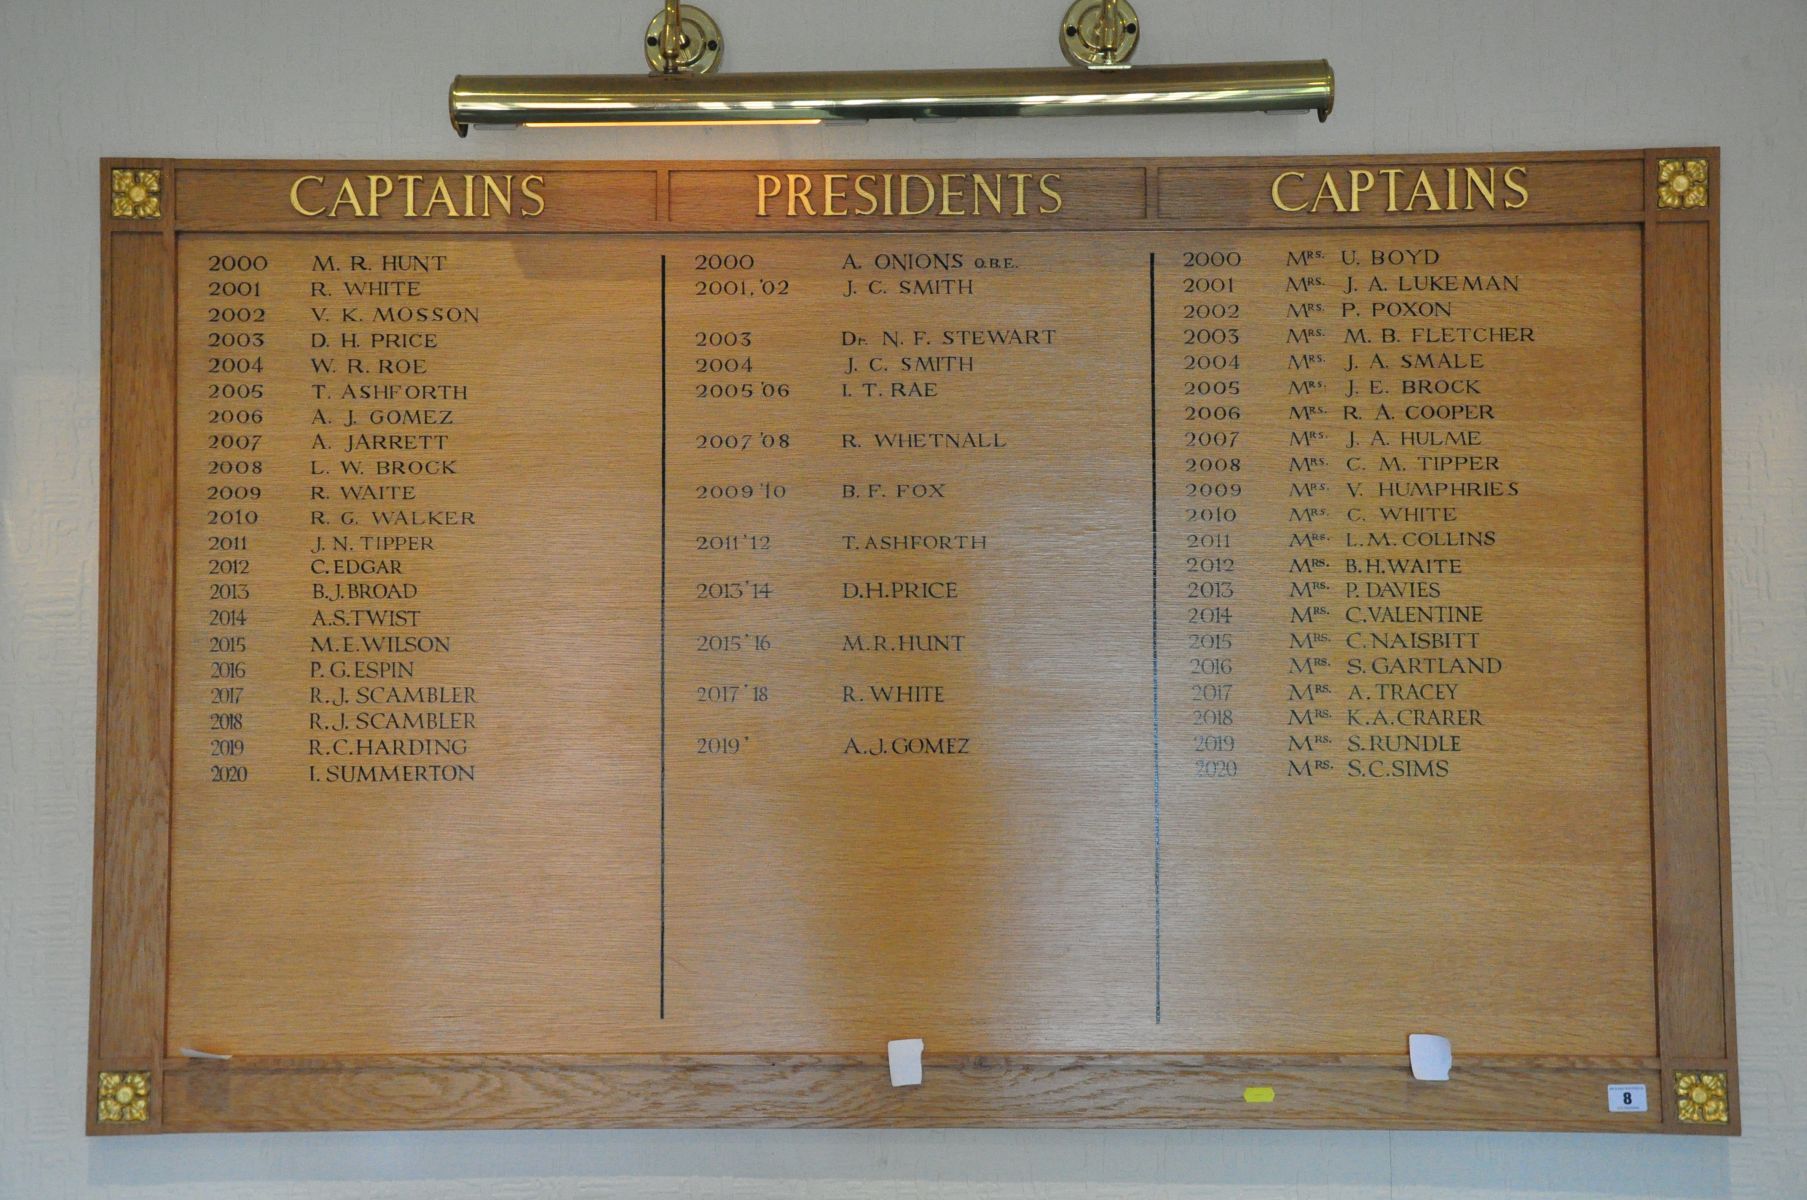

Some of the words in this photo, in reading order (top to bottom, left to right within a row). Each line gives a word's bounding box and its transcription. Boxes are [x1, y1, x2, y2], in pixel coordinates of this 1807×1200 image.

[290, 175, 544, 216] CAPTAINS
[757, 174, 1061, 215] PRESIDENTS
[1272, 167, 1528, 211] CAPTAINS
[209, 256, 268, 271] 2000
[312, 256, 340, 271] M.
[350, 256, 371, 271] R.
[383, 255, 447, 272] HUNT
[695, 255, 754, 270] 2000
[842, 254, 862, 269] A.
[875, 253, 963, 271] ONIONS
[1183, 252, 1241, 267] 2000
[1342, 250, 1360, 265] U.
[1372, 249, 1439, 265] BOYD
[209, 282, 260, 297] 2001
[311, 282, 331, 297] R.
[344, 281, 421, 296] WHITE
[843, 280, 856, 297] J.
[869, 280, 886, 294] C.
[900, 279, 973, 295] SMITH
[1183, 277, 1233, 292] 2001
[1344, 276, 1357, 294] J.
[1368, 276, 1387, 291] A.
[1399, 276, 1518, 291] LUKEMAN
[208, 308, 265, 322] 2002
[311, 308, 329, 322] V.
[343, 308, 363, 323] K.
[373, 307, 479, 323] MOSSON
[1184, 304, 1239, 318] 2002
[1342, 302, 1360, 317] P.
[1372, 302, 1451, 317] POXON
[208, 333, 264, 347] 2003
[312, 333, 329, 348] D.
[342, 333, 360, 348] H.
[371, 333, 437, 348] PRICE
[695, 332, 751, 347] 2003
[883, 331, 903, 348] N.
[913, 331, 930, 345] F.
[942, 329, 1056, 345] STEWART
[1184, 329, 1239, 344] 2003
[1344, 328, 1371, 343] M.
[1382, 328, 1400, 343] B.
[1412, 327, 1535, 343] FLETCHER
[208, 356, 263, 373] 2004
[311, 358, 335, 373] W.
[348, 359, 369, 374] R.
[379, 359, 427, 374] ROE
[696, 356, 752, 373] 2004
[844, 357, 857, 375] J.
[870, 358, 887, 372] C.
[901, 356, 973, 372] SMITH
[1184, 355, 1239, 370] 2004
[1344, 355, 1358, 372] J.
[1370, 353, 1388, 369] A.
[1401, 353, 1484, 369] SMALE
[208, 384, 263, 399] 2005
[312, 384, 331, 399] T.
[341, 384, 467, 400] ASHFORTH
[842, 384, 851, 397] I.
[862, 383, 882, 397] T.
[891, 382, 938, 397] RAE
[1185, 381, 1239, 395] 2005
[1345, 379, 1358, 398] J.
[1370, 380, 1389, 394] E.
[1402, 380, 1480, 394] BROCK
[208, 409, 263, 424] 2006
[312, 408, 331, 424] A.
[344, 410, 356, 427] J.
[370, 410, 453, 424] GOMEZ
[1185, 406, 1240, 420] 2006
[1344, 406, 1362, 420] R.
[1374, 403, 1395, 420] A.
[1405, 405, 1495, 420] COOPER
[208, 435, 262, 451] 2007
[312, 433, 331, 449] A.
[344, 434, 448, 453] JARRETT
[842, 434, 861, 448] R.
[874, 432, 1007, 448] WHETNALL
[1185, 432, 1239, 448] 2007
[1346, 431, 1359, 448] J.
[1370, 430, 1389, 446] A.
[1401, 431, 1481, 446] HULME
[208, 461, 262, 474] 2008
[311, 461, 329, 474] L.
[340, 461, 363, 475] W.
[377, 460, 457, 475] BROCK
[1186, 458, 1240, 472] 2008
[1347, 457, 1365, 471] C.
[1380, 456, 1406, 471] M.
[1417, 456, 1499, 471] TIPPER
[208, 486, 261, 500] 2009
[311, 486, 329, 500] R.
[340, 485, 416, 500] WAITE
[843, 484, 860, 498] B.
[868, 484, 886, 498] F.
[897, 484, 946, 498] FOX
[1186, 483, 1241, 497] 2009
[1347, 483, 1362, 498] V.
[1379, 482, 1518, 496] HUMPHRIES
[208, 509, 258, 525] 2010
[311, 511, 329, 525] R.
[341, 512, 358, 525] G.
[372, 510, 475, 525] WALKER
[1186, 507, 1236, 522] 2010
[1347, 508, 1365, 521] C.
[1380, 507, 1457, 522] WHITE
[208, 536, 246, 550] 2011
[311, 536, 325, 553] J.
[333, 536, 353, 552] N.
[360, 536, 434, 550] TIPPER
[1187, 534, 1230, 548] 2011
[209, 560, 249, 575] 2012
[1187, 558, 1234, 572] 2012
[210, 584, 249, 600] 2013
[1186, 581, 1234, 598] 2013
[210, 608, 247, 626] 2014
[1188, 607, 1232, 624] 2014
[210, 637, 246, 652] 2015
[1189, 634, 1232, 649] 2015
[211, 662, 246, 678] 2016
[1190, 658, 1232, 674] 2016
[211, 688, 244, 704] 2017
[210, 713, 242, 730] 2018
[211, 739, 244, 756] 2019
[211, 765, 248, 782] 2020
[1623, 1092, 1632, 1105] 8
